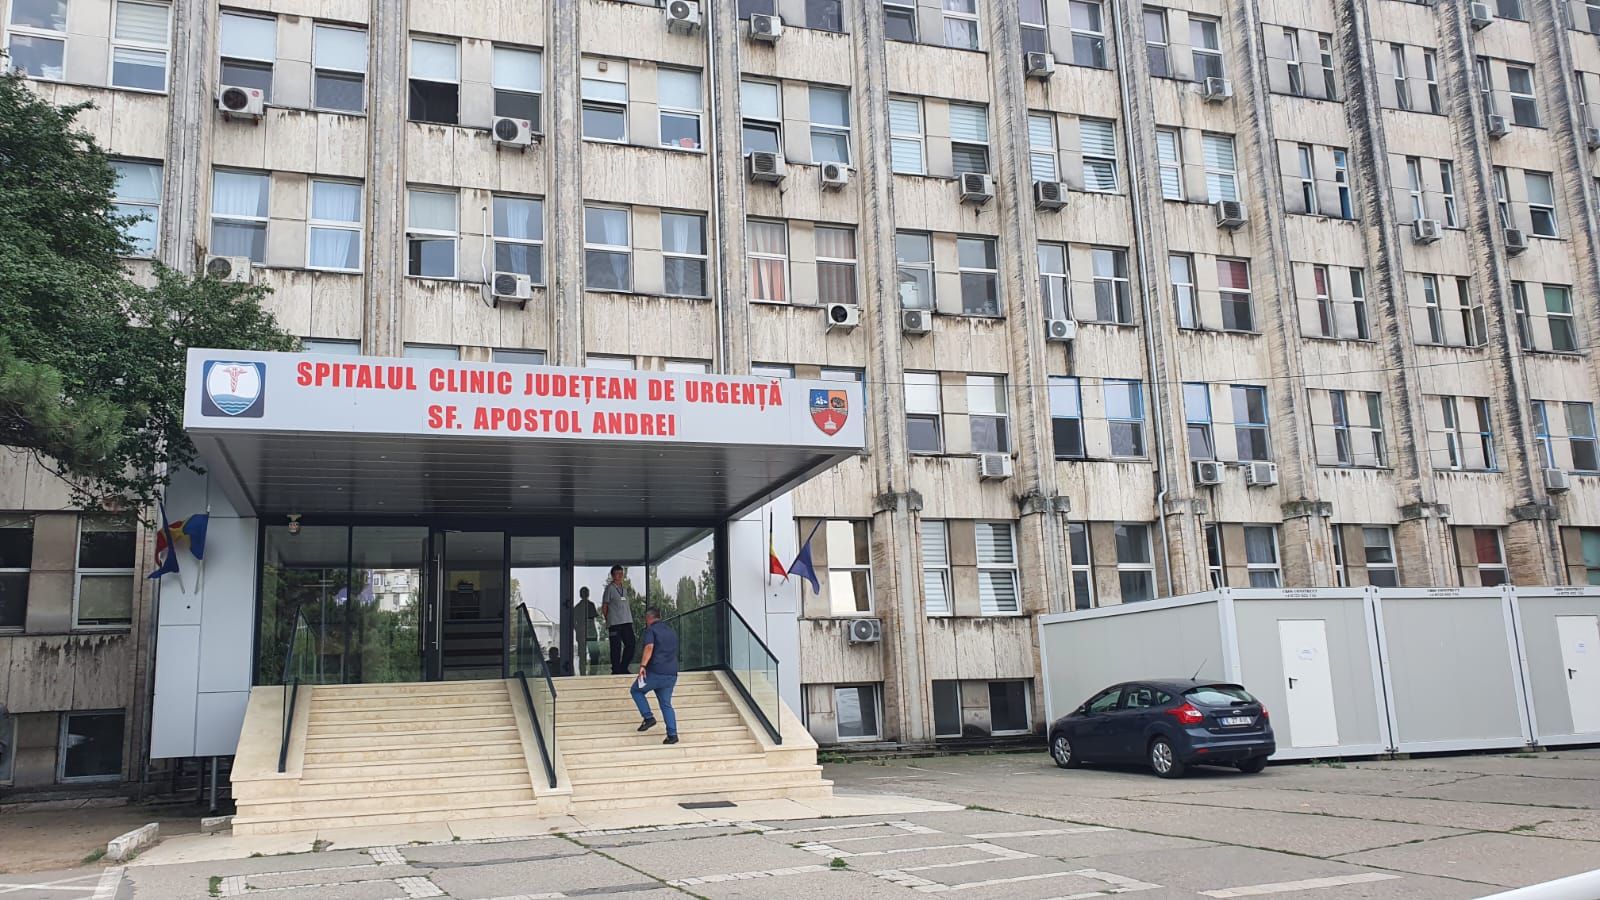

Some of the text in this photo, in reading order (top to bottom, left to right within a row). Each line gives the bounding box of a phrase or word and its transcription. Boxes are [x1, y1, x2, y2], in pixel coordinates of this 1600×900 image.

[297, 361, 783, 410] SPITALUL CLINIC JUDEȚEAN DE URGENȚĂ
[428, 404, 675, 436] SF. APOSTOL ANDREI
